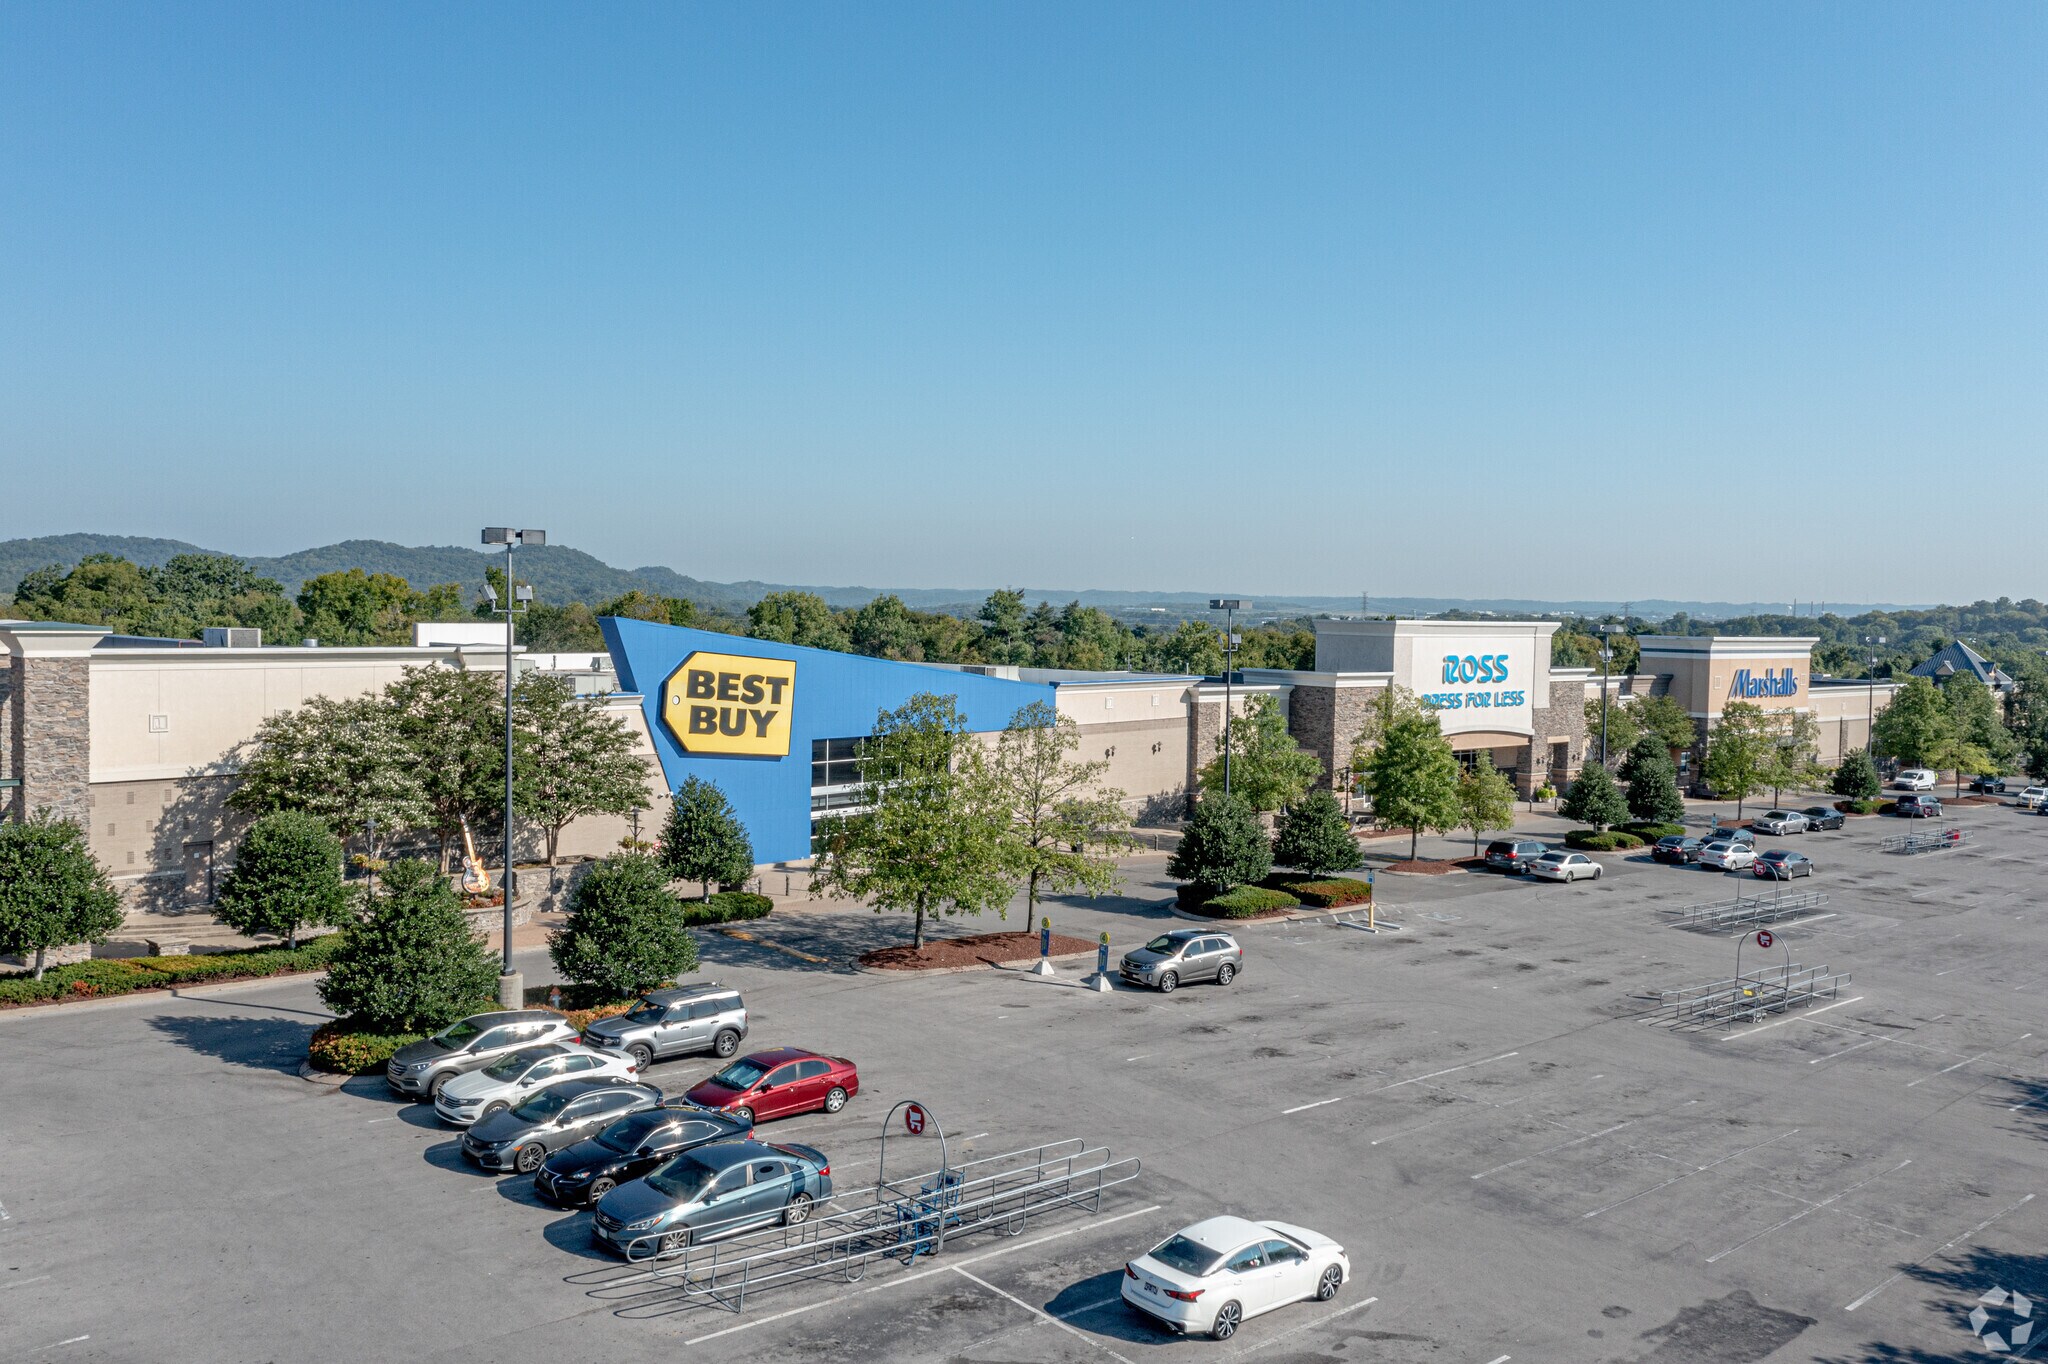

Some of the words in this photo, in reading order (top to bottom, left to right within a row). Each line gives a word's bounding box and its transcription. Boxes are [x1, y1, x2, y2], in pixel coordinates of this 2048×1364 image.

[1443, 654, 1509, 685] ROSS
[1728, 668, 1798, 699] Marshalls
[686, 669, 789, 705] BEST
[1465, 692, 1492, 708] FOR
[1494, 690, 1525, 708] LESS
[689, 705, 778, 738] BUY
